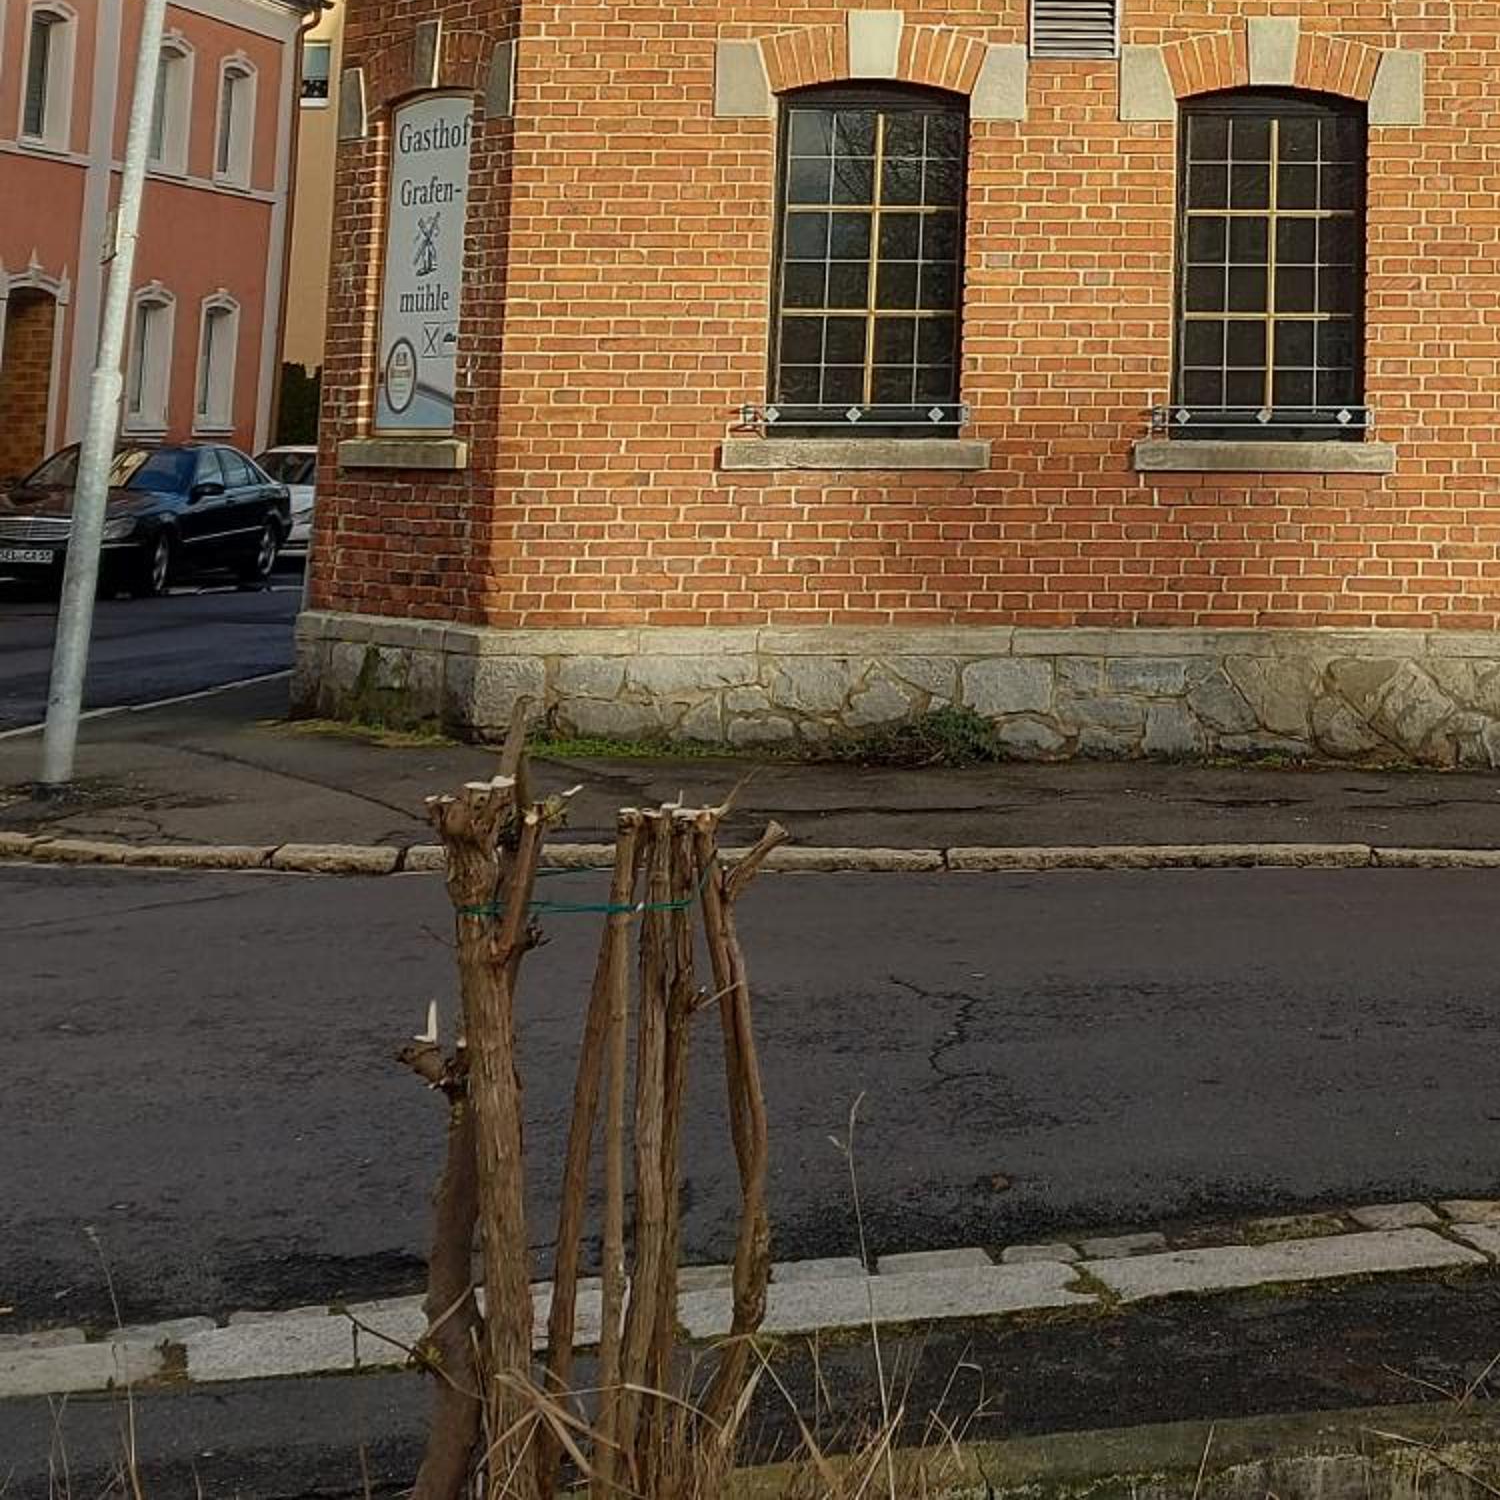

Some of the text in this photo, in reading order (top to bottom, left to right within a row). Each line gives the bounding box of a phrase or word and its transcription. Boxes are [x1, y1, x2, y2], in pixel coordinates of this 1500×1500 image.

[400, 114, 473, 154] Gasthof
[401, 175, 462, 207] Grafen-
[400, 283, 449, 312] mühle
